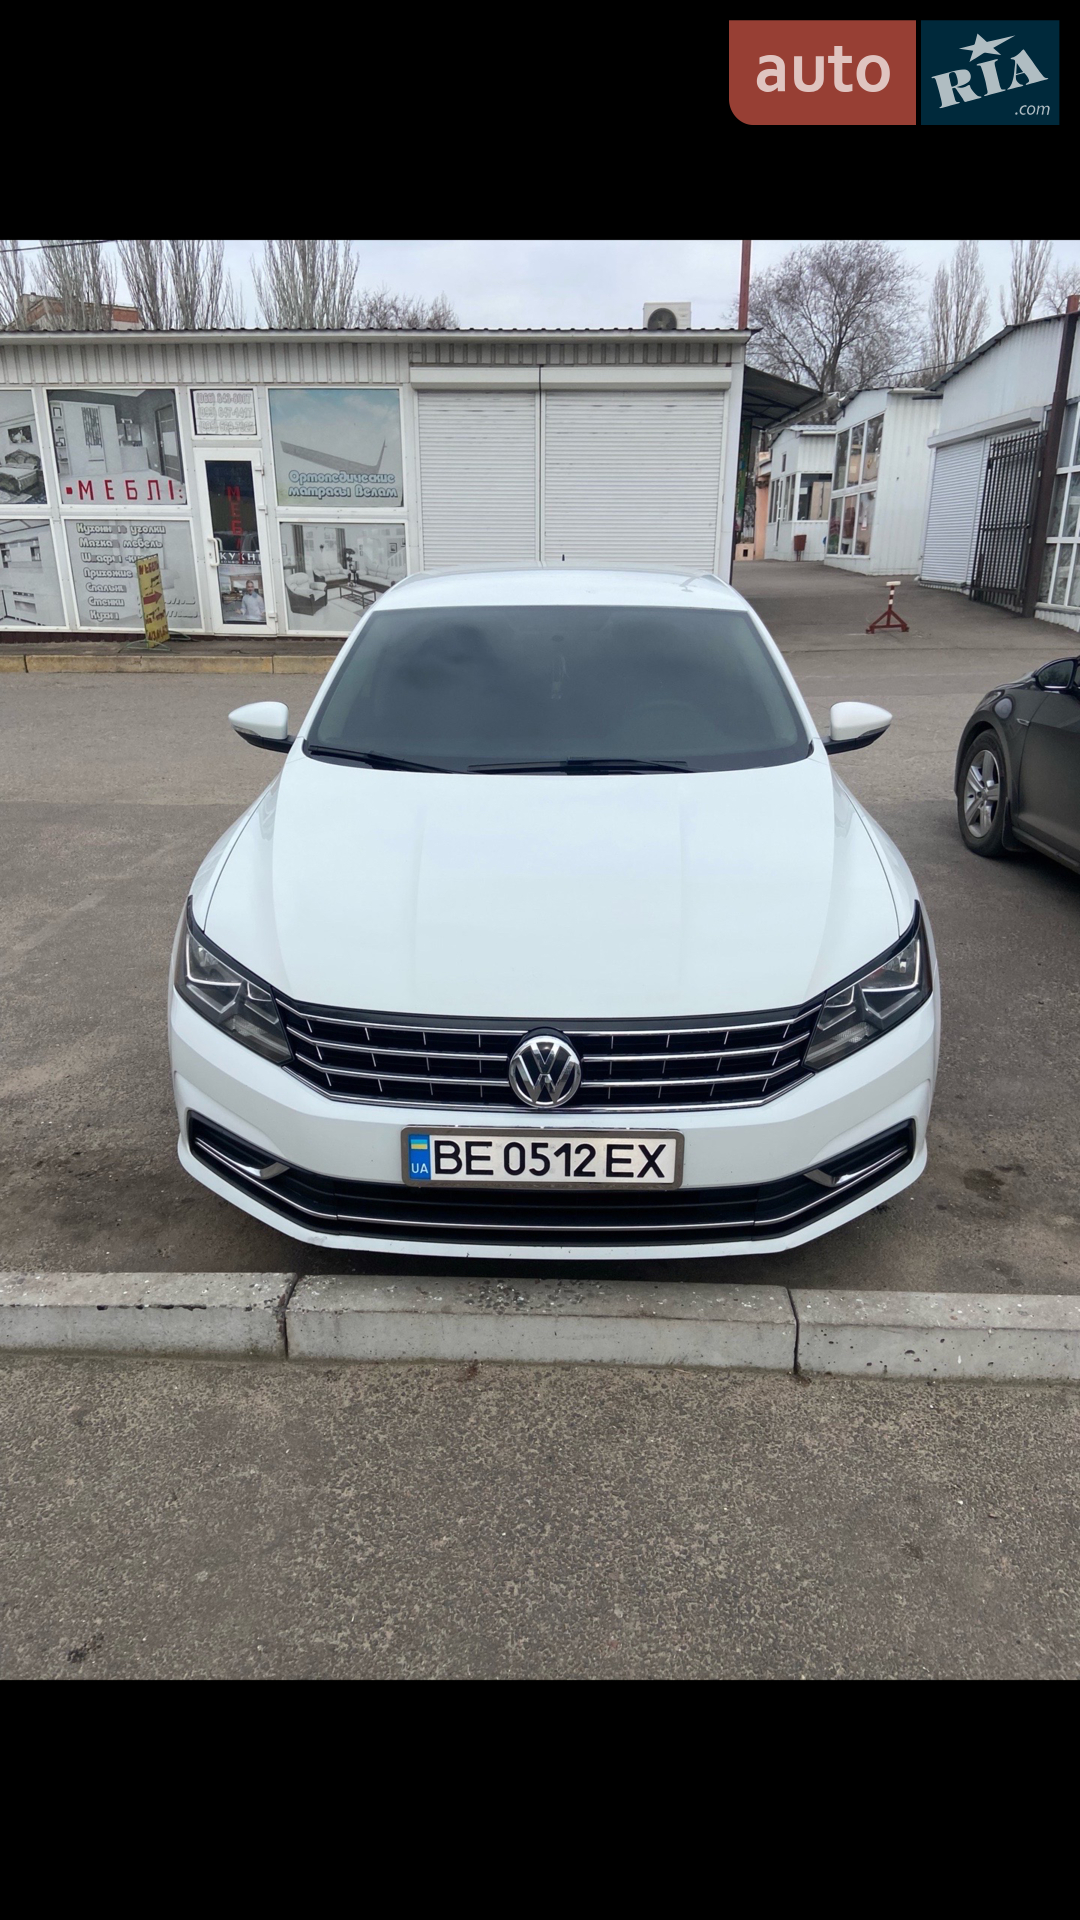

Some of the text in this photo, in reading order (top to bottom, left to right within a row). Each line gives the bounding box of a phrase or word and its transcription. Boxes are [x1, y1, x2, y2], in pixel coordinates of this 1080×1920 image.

[288, 470, 395, 485] Ортопедические
[288, 484, 398, 500] матрасы Велам
[130, 525, 166, 536] уголки
[123, 538, 163, 548] мебель
[83, 567, 133, 580] Прихожие
[88, 597, 125, 606] Стенки
[434, 1140, 666, 1178] BE 0512 EX
[411, 1163, 429, 1174] UA
